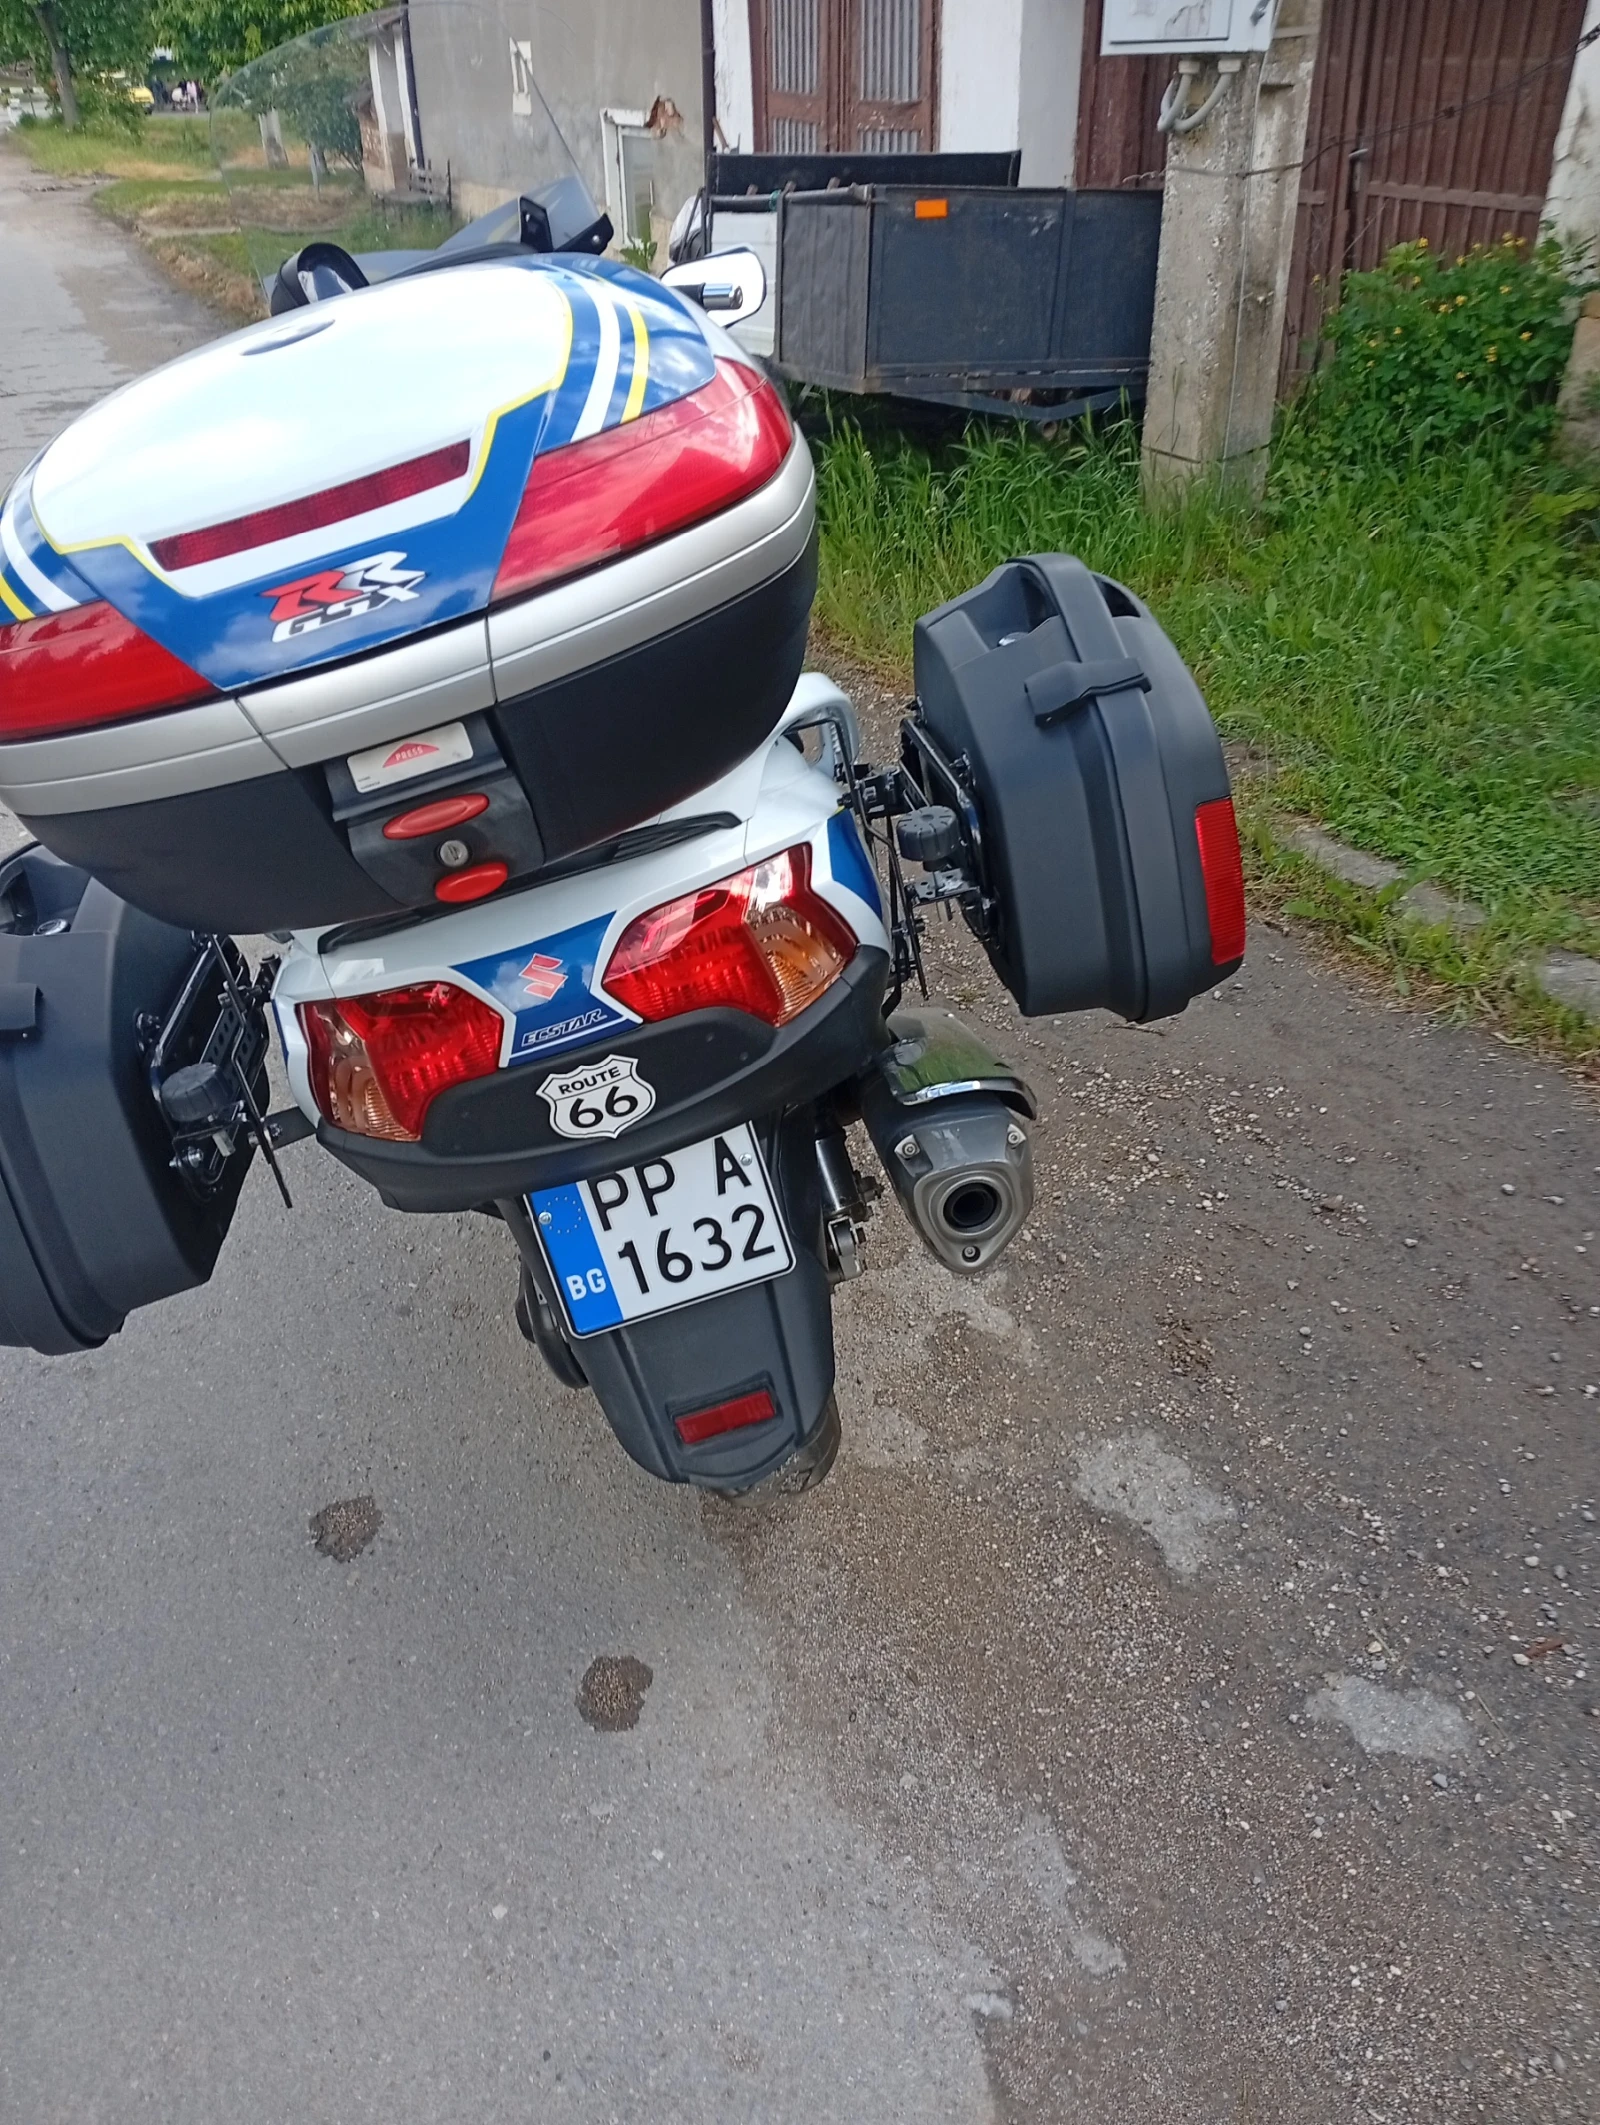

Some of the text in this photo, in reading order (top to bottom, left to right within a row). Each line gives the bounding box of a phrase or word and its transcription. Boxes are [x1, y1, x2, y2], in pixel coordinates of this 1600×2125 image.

[394, 745, 425, 762] PRESS
[521, 1008, 608, 1047] ECSTAR
[558, 1066, 621, 1095] ROUTE
[569, 1085, 639, 1129] 66
[586, 1136, 752, 1232] PP A
[617, 1203, 776, 1295] 1632
[566, 1268, 607, 1301] BG
